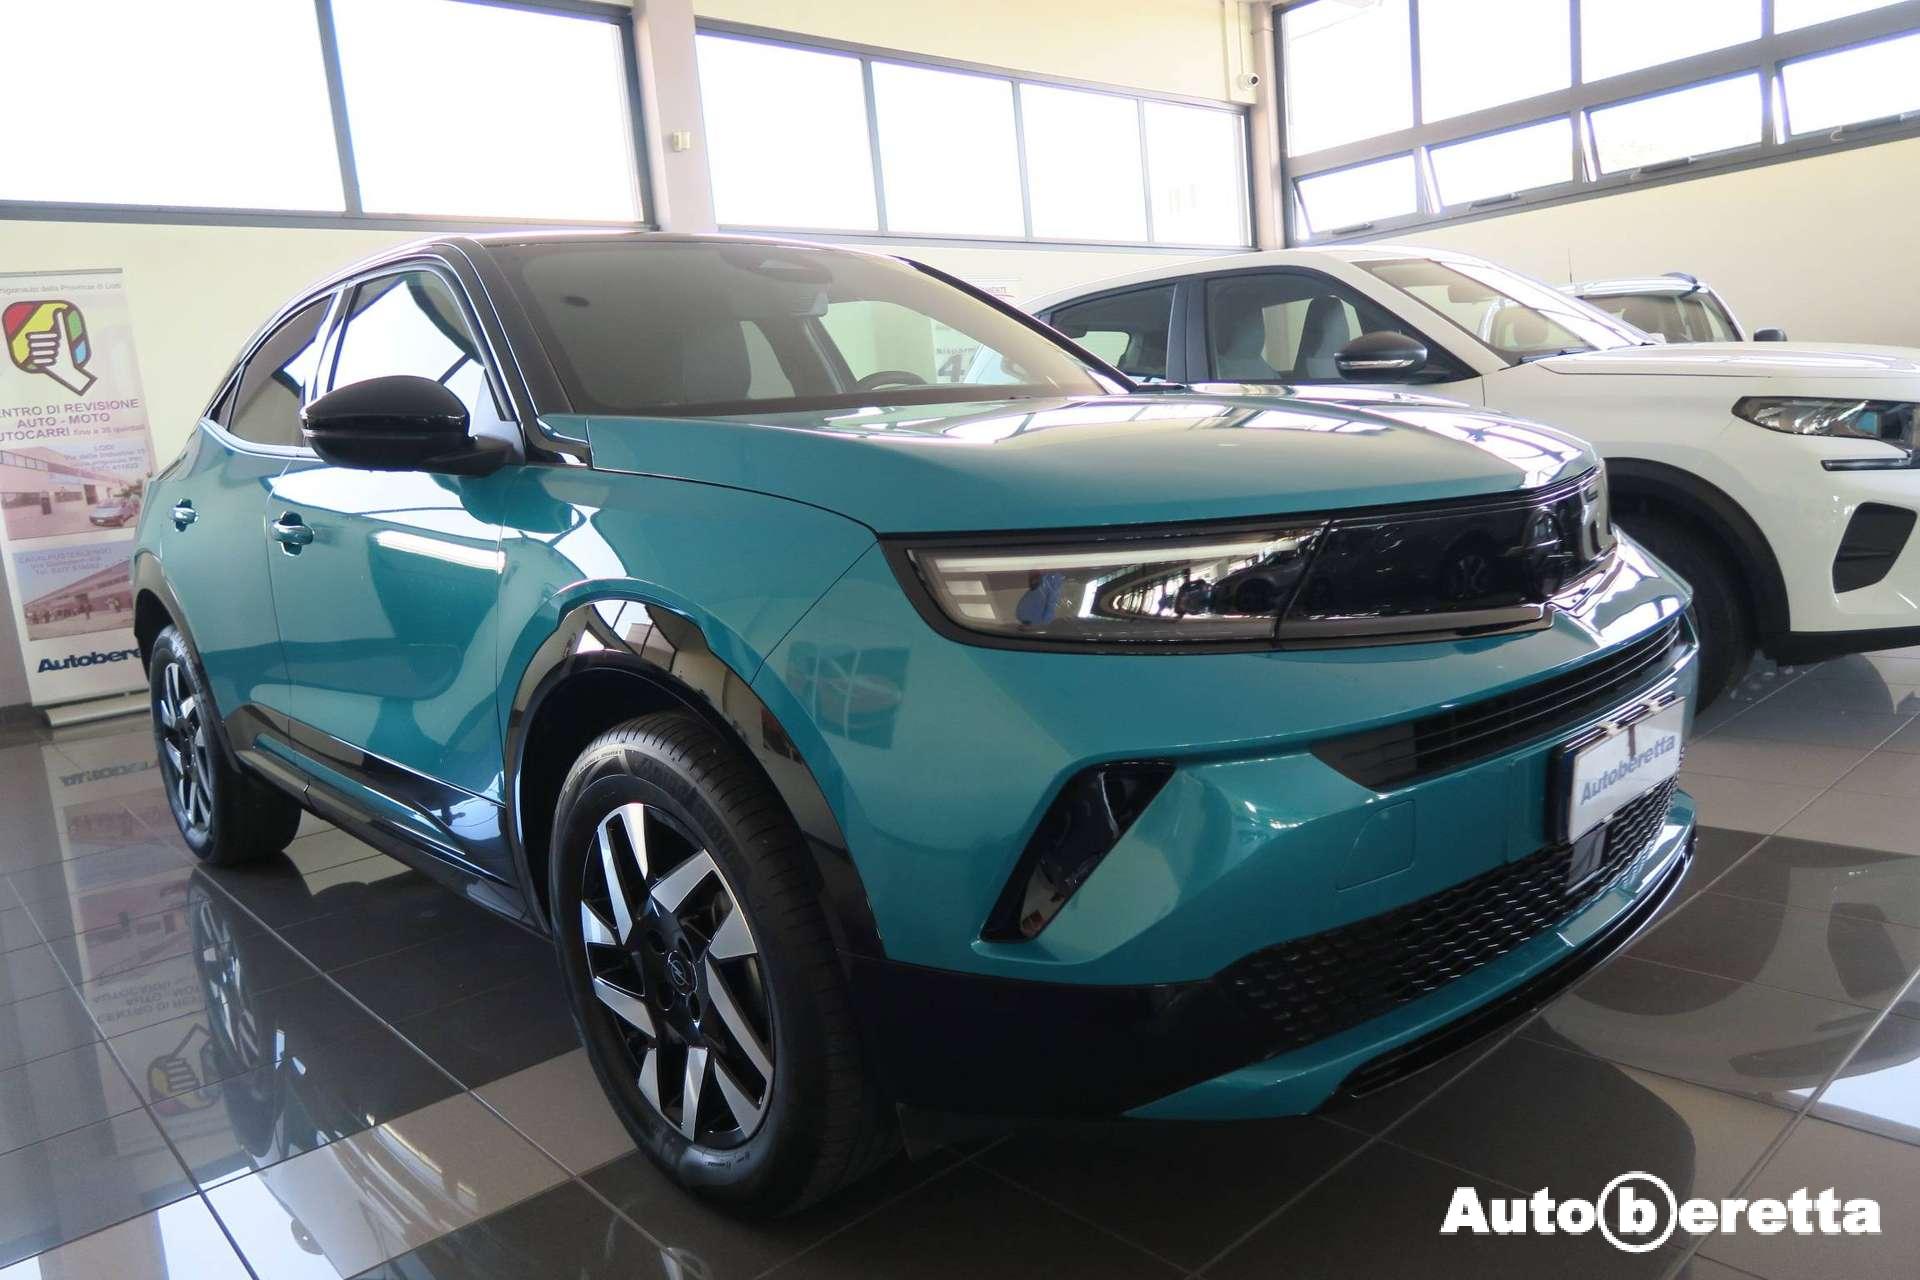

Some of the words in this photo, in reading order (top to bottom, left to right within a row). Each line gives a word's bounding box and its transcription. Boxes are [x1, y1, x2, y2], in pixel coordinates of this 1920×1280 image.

[46, 404, 60, 415] DI
[64, 398, 139, 413] REVISIONE
[17, 416, 57, 429] AUTO
[69, 412, 111, 424] MOTO
[1580, 734, 1676, 806] Autoberetta
